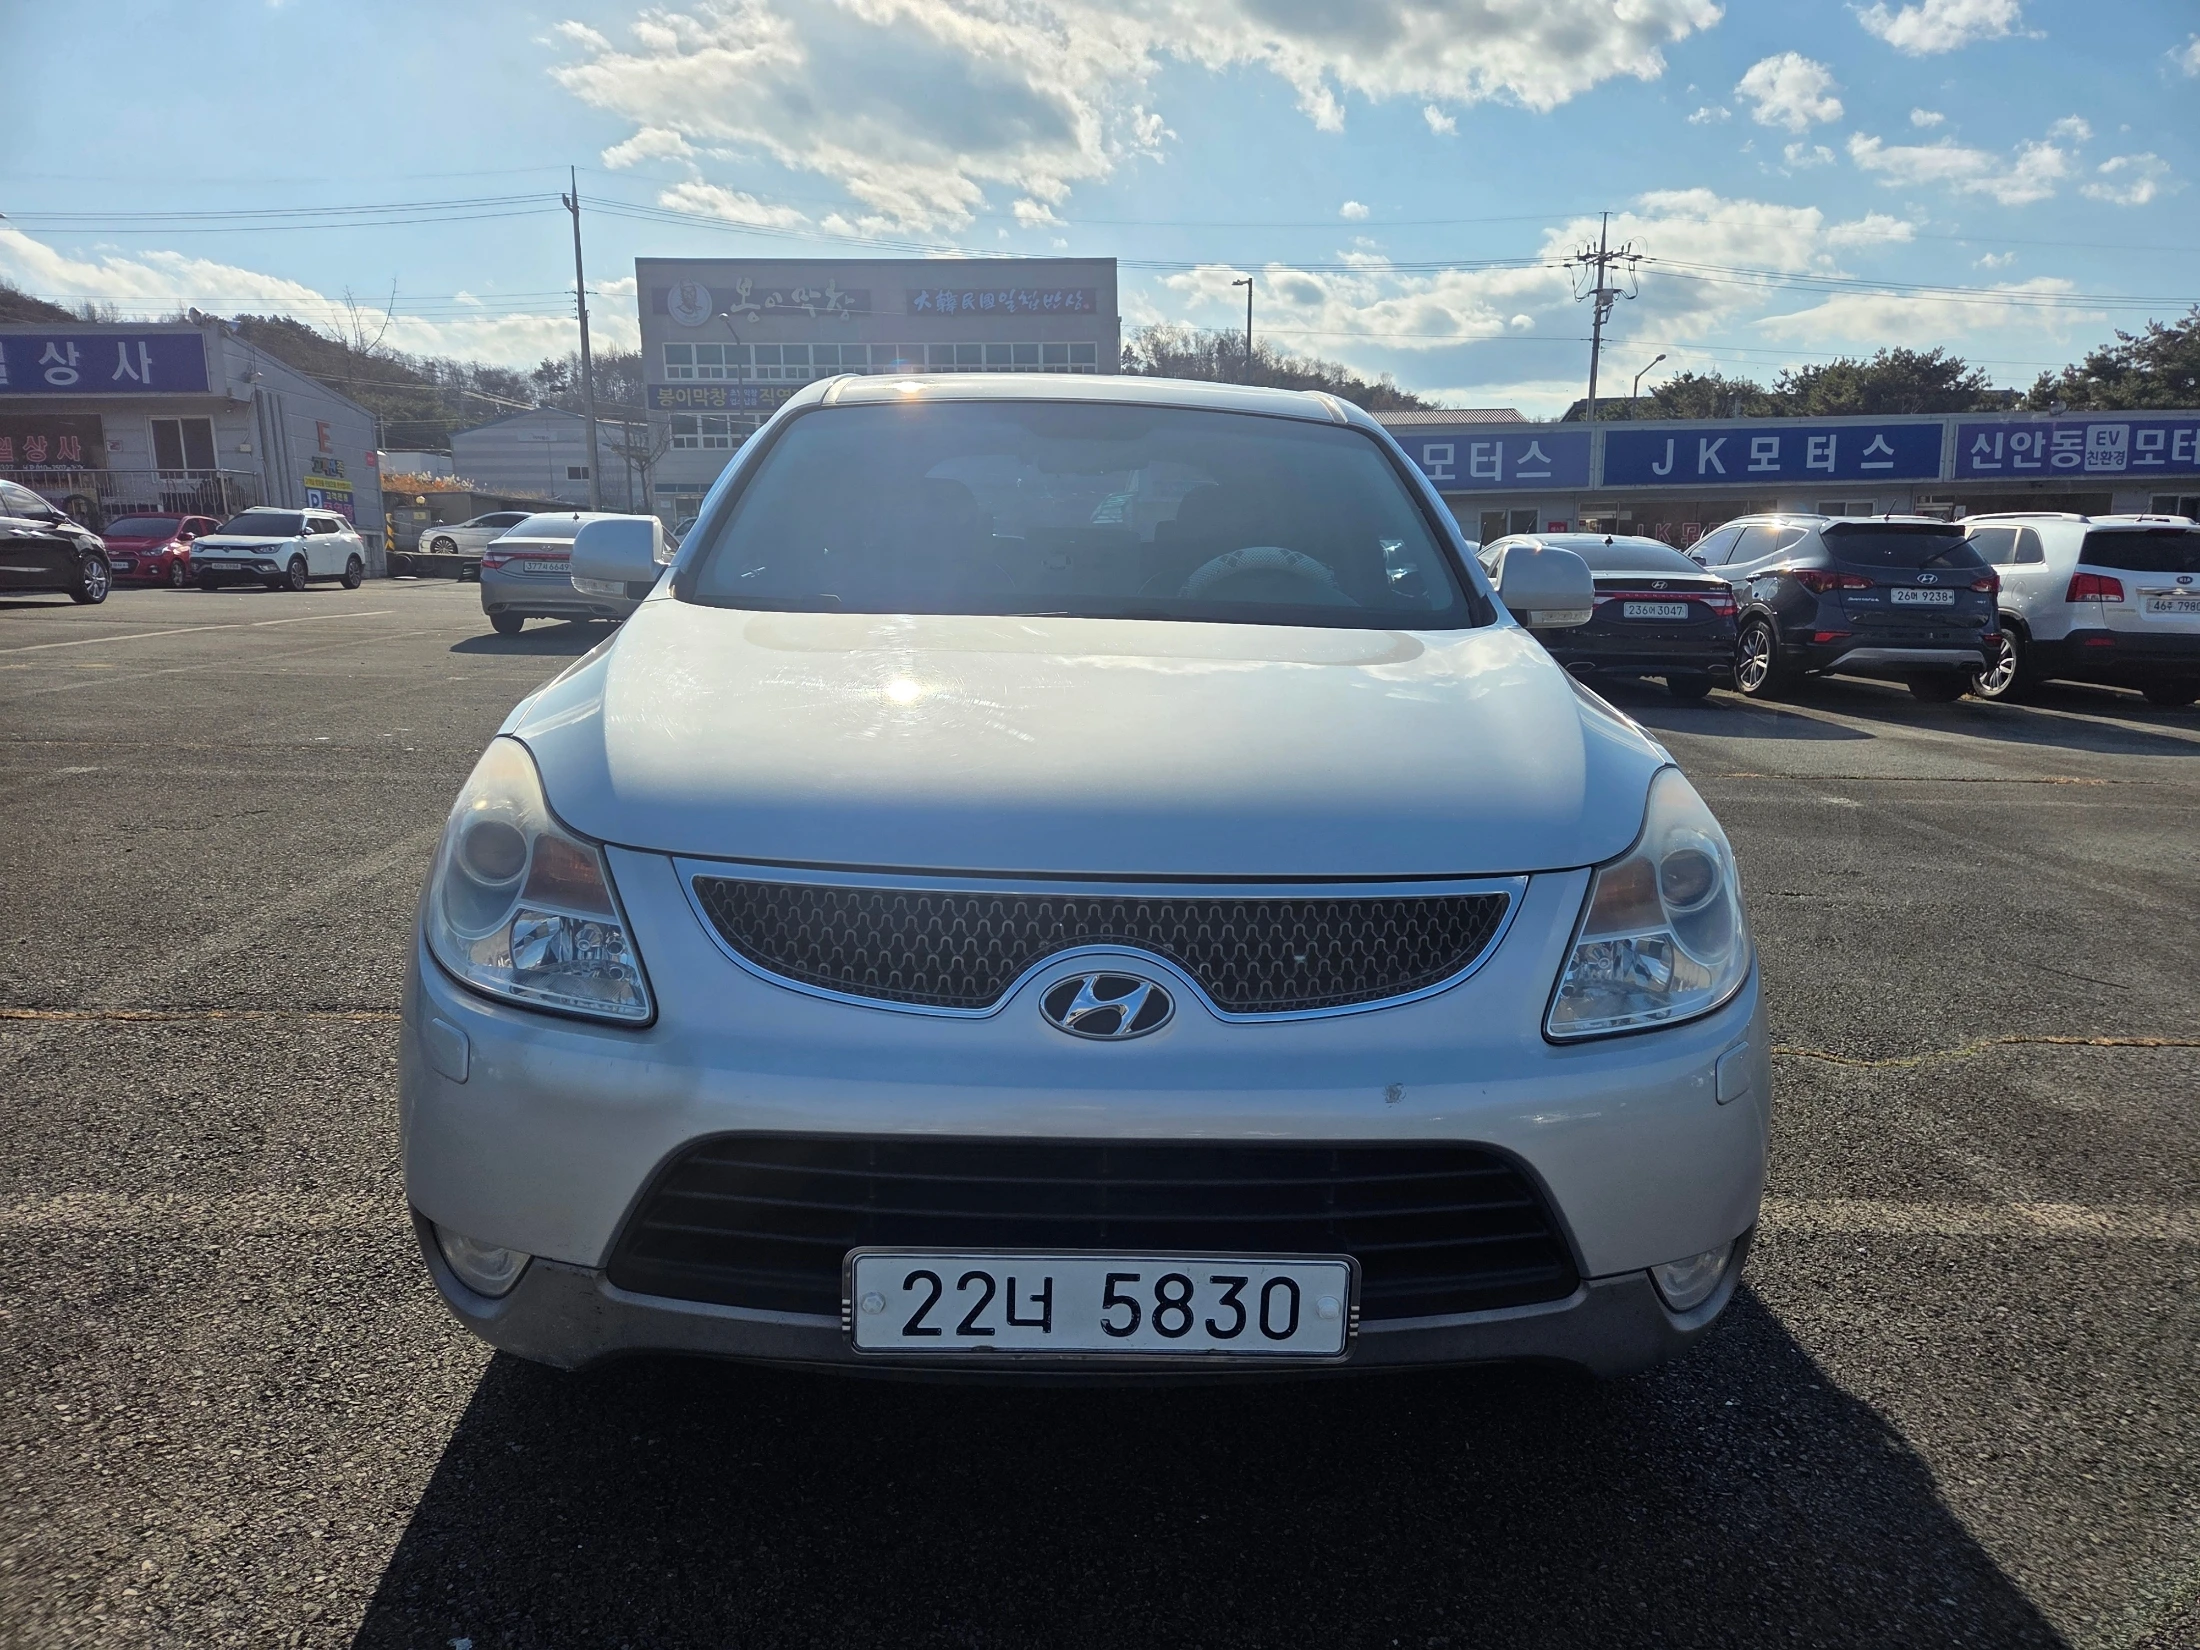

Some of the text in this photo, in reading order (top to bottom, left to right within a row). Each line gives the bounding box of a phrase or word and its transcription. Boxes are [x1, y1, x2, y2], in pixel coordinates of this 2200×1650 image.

[0, 341, 153, 386] 상사
[657, 387, 728, 407] 봉이막창
[759, 387, 800, 406] 직영
[2096, 430, 2120, 446] EV
[1970, 430, 2084, 469] 신안동
[2087, 450, 2126, 466] 친환경
[1422, 440, 1552, 482] 모터스
[1923, 591, 1948, 601] 9238
[901, 1269, 1301, 1341] 22너 5830
